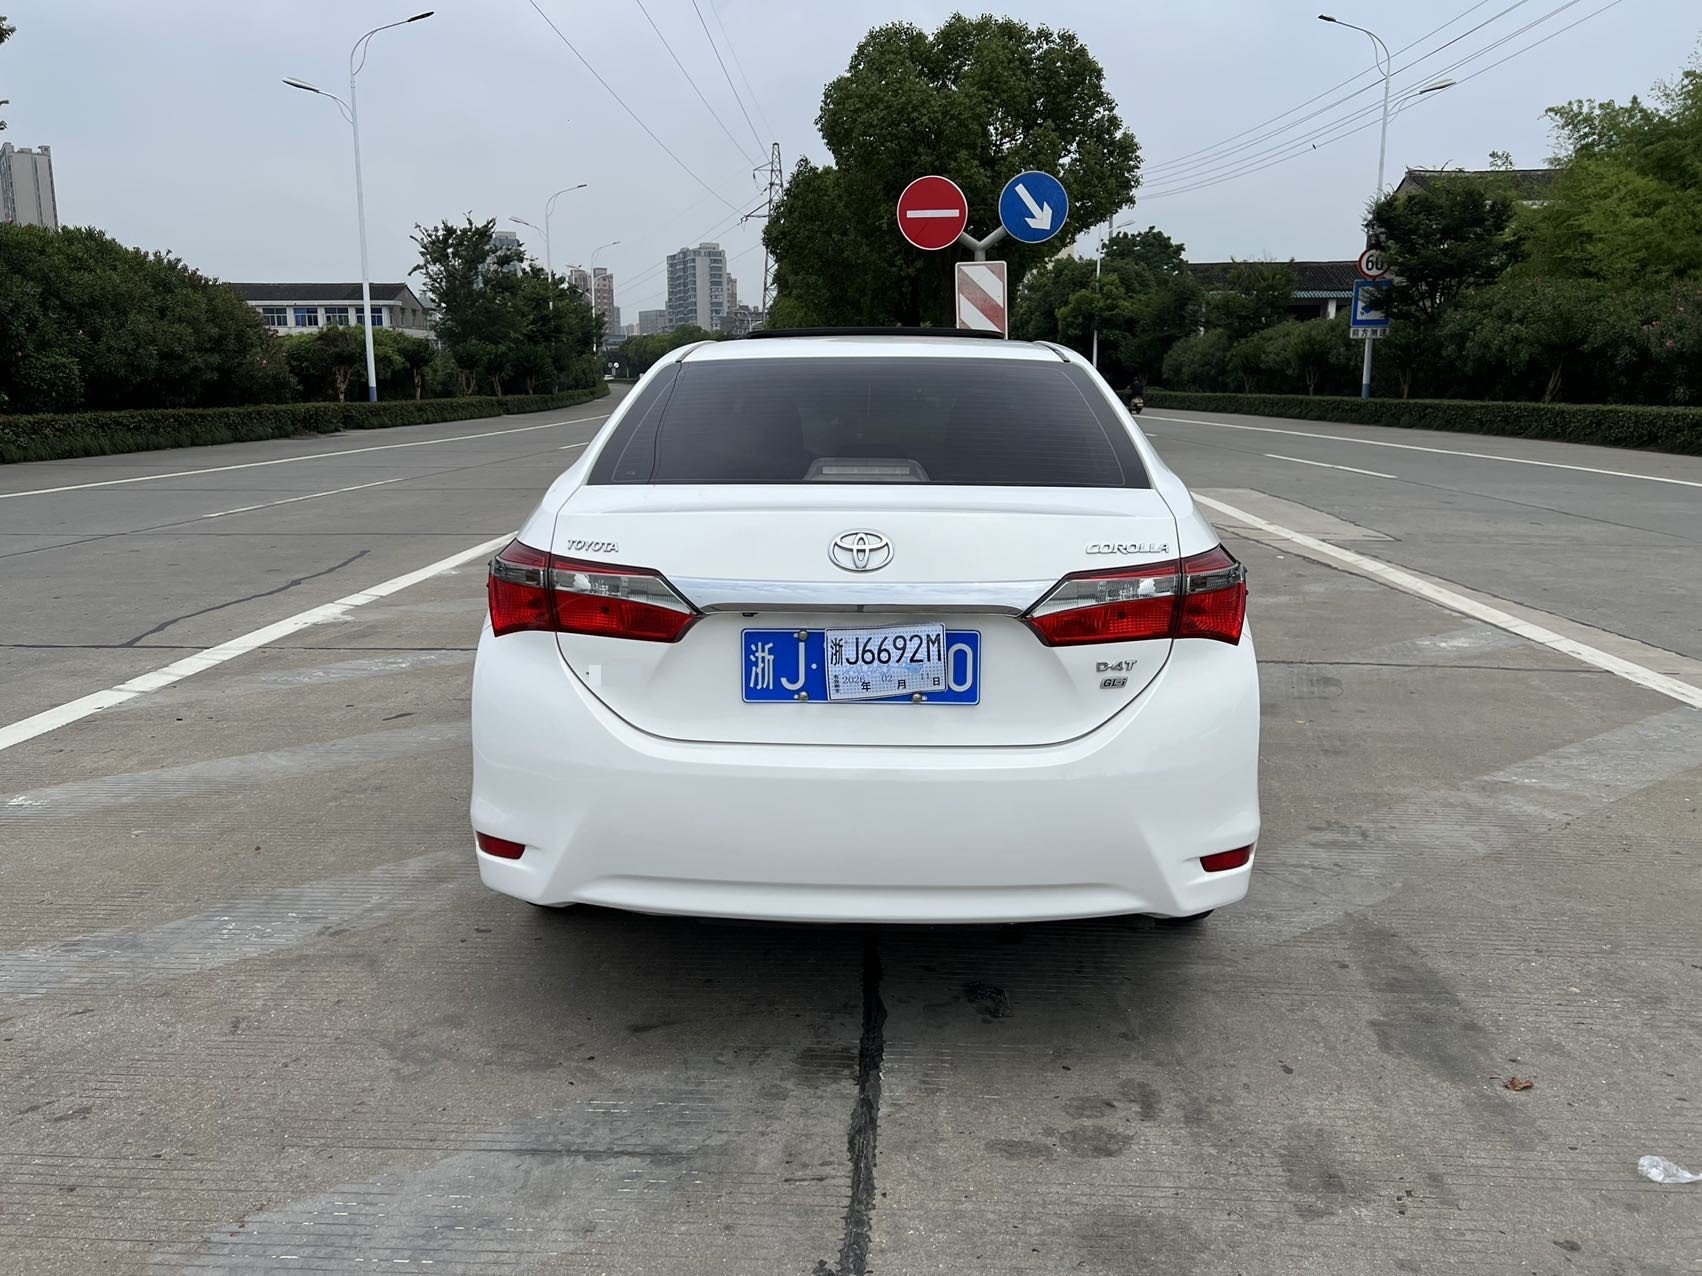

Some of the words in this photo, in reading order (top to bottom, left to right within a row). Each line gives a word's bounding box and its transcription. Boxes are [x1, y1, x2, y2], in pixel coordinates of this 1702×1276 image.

[1365, 254, 1384, 271] 60
[567, 539, 619, 553] TOYOTA
[1085, 542, 1169, 555] COROLLA
[829, 633, 942, 667] 浙J6692M
[1096, 659, 1137, 673] D-4T
